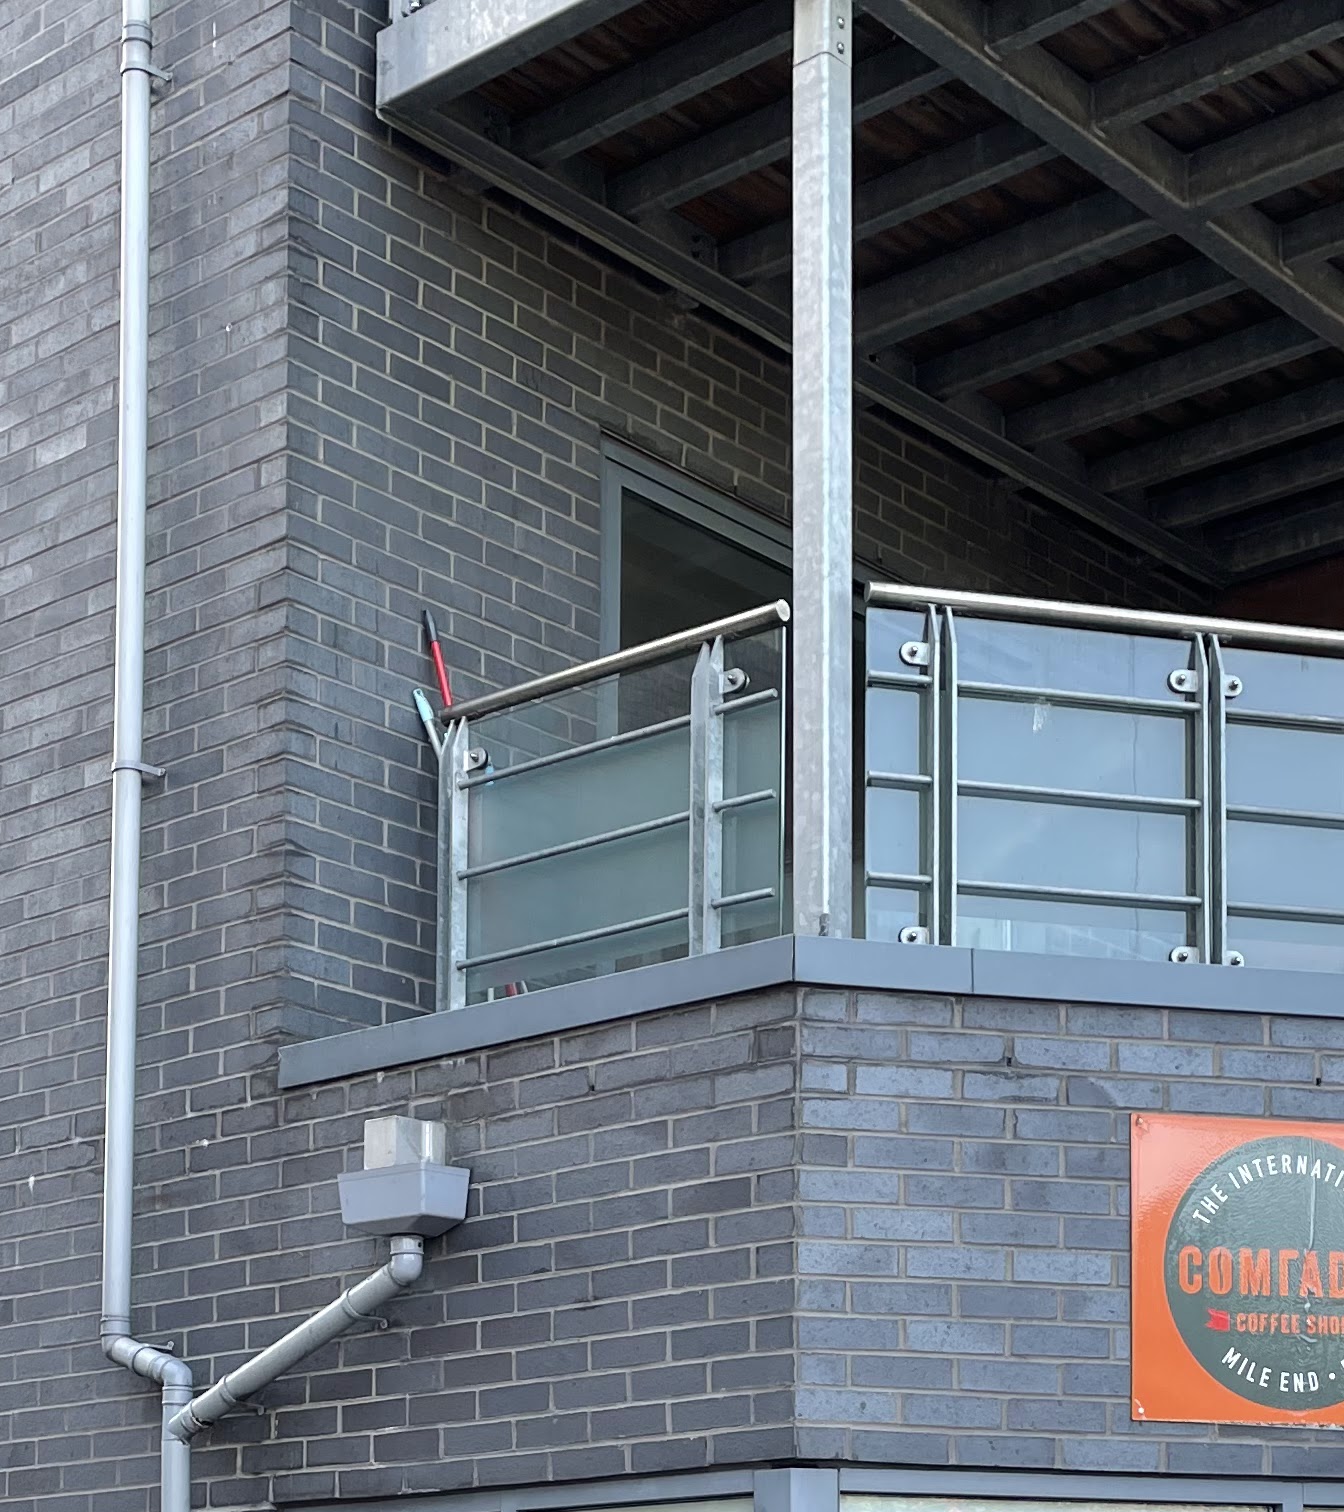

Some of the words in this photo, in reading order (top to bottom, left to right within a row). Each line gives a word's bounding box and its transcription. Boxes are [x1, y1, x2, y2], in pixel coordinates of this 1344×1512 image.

[1192, 1183, 1229, 1225] THE
[1236, 1312, 1301, 1334] COFFEE
[1221, 1346, 1272, 1389] MILE
[1280, 1370, 1320, 1393] END
